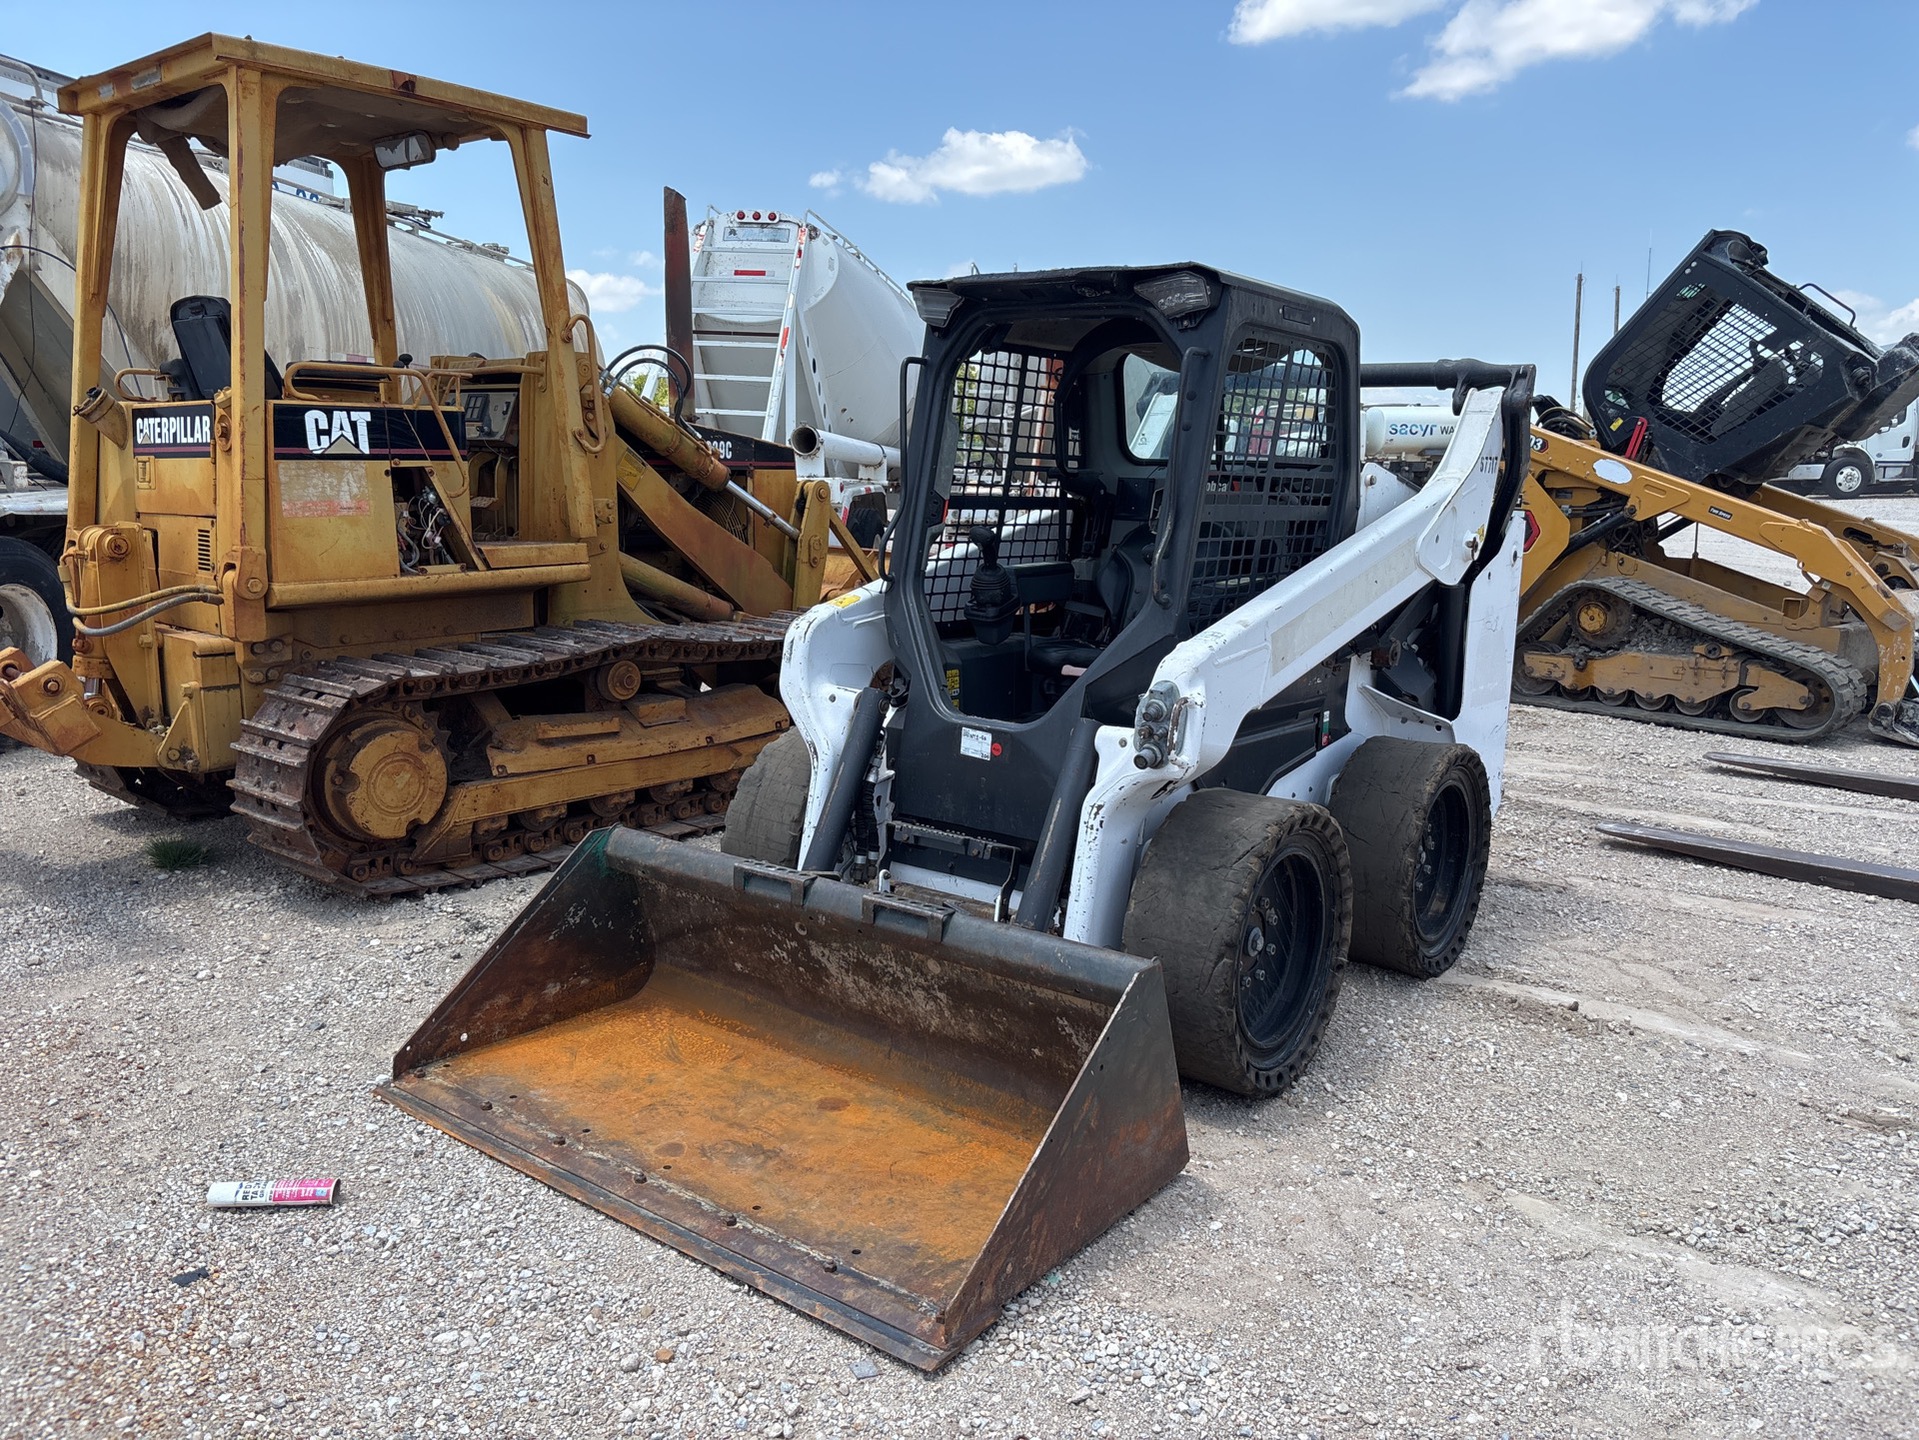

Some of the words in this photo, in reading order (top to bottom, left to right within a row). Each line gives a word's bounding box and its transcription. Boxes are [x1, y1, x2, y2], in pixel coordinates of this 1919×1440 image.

[136, 415, 211, 445] CATERPILLAR
[304, 409, 372, 455] CAT
[1440, 425, 1456, 435] WA
[706, 440, 733, 459] 9C
